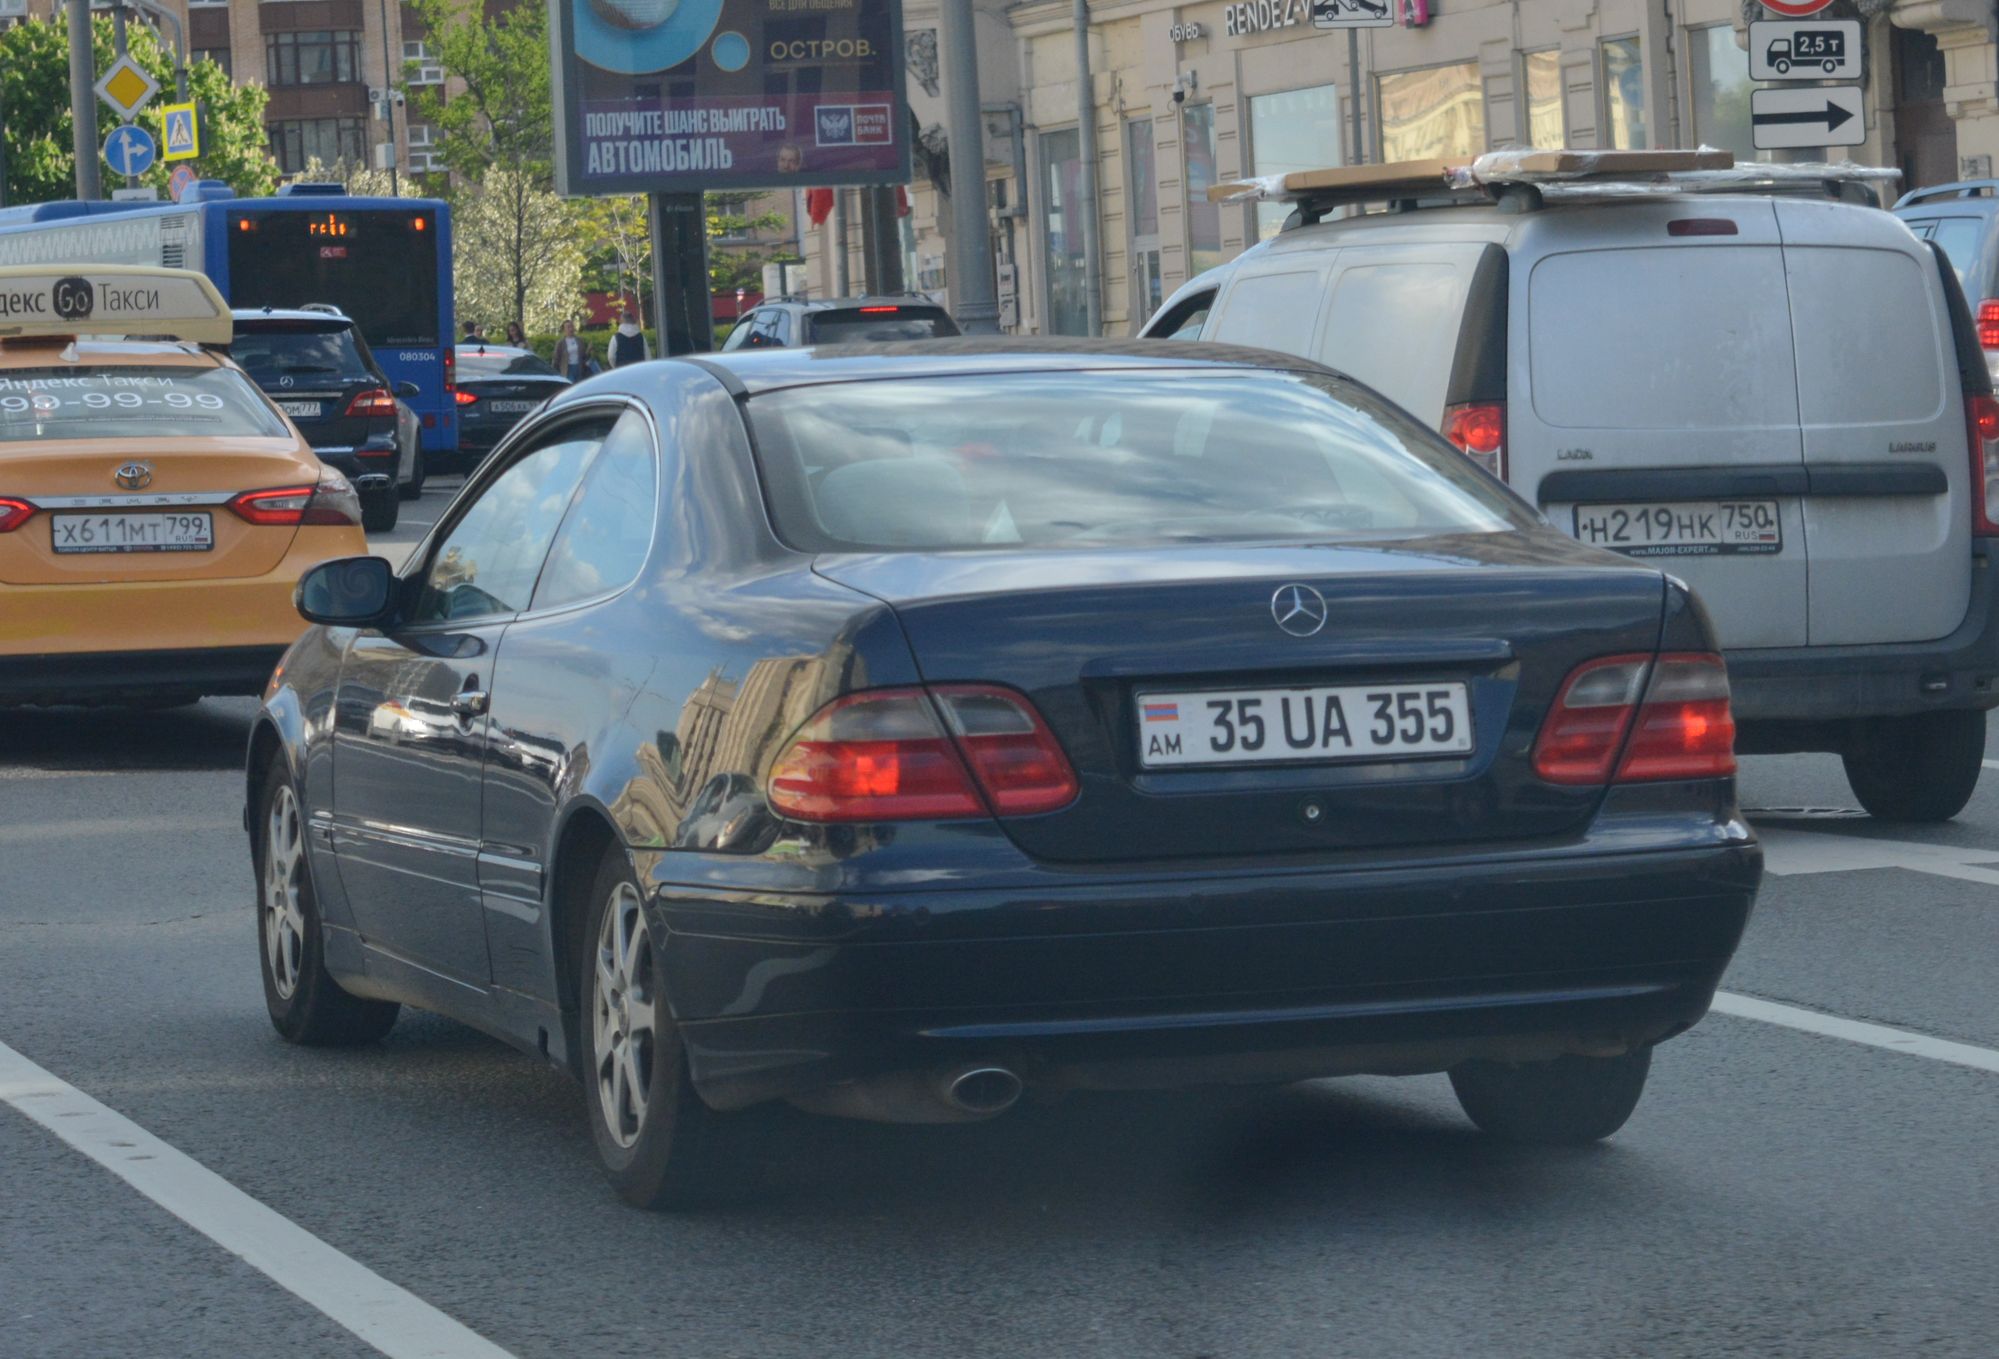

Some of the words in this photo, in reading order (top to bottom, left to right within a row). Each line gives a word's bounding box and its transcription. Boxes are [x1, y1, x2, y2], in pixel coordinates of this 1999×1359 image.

[770, 39, 877, 59] ОСТРОВ.
[1800, 36, 1825, 54] 2,5
[586, 111, 663, 137] ПОЛУЧИТЕ
[664, 109, 708, 135] ШАНС
[709, 107, 786, 133] ВЫИГРАТЬ
[588, 138, 733, 174] АВТОМОБИЛЬ
[59, 283, 89, 312] Go
[98, 283, 159, 311] Такси
[400, 352, 435, 361] 080304
[97, 373, 173, 388] Такси
[166, 516, 203, 535] 799
[1721, 504, 1768, 530] 750
[175, 535, 193, 543] RUS
[1735, 530, 1757, 540] RUS
[1206, 698, 1265, 753] 35
[1281, 695, 1352, 750] UA
[1366, 690, 1455, 745] 355
[1148, 734, 1183, 757] AM
